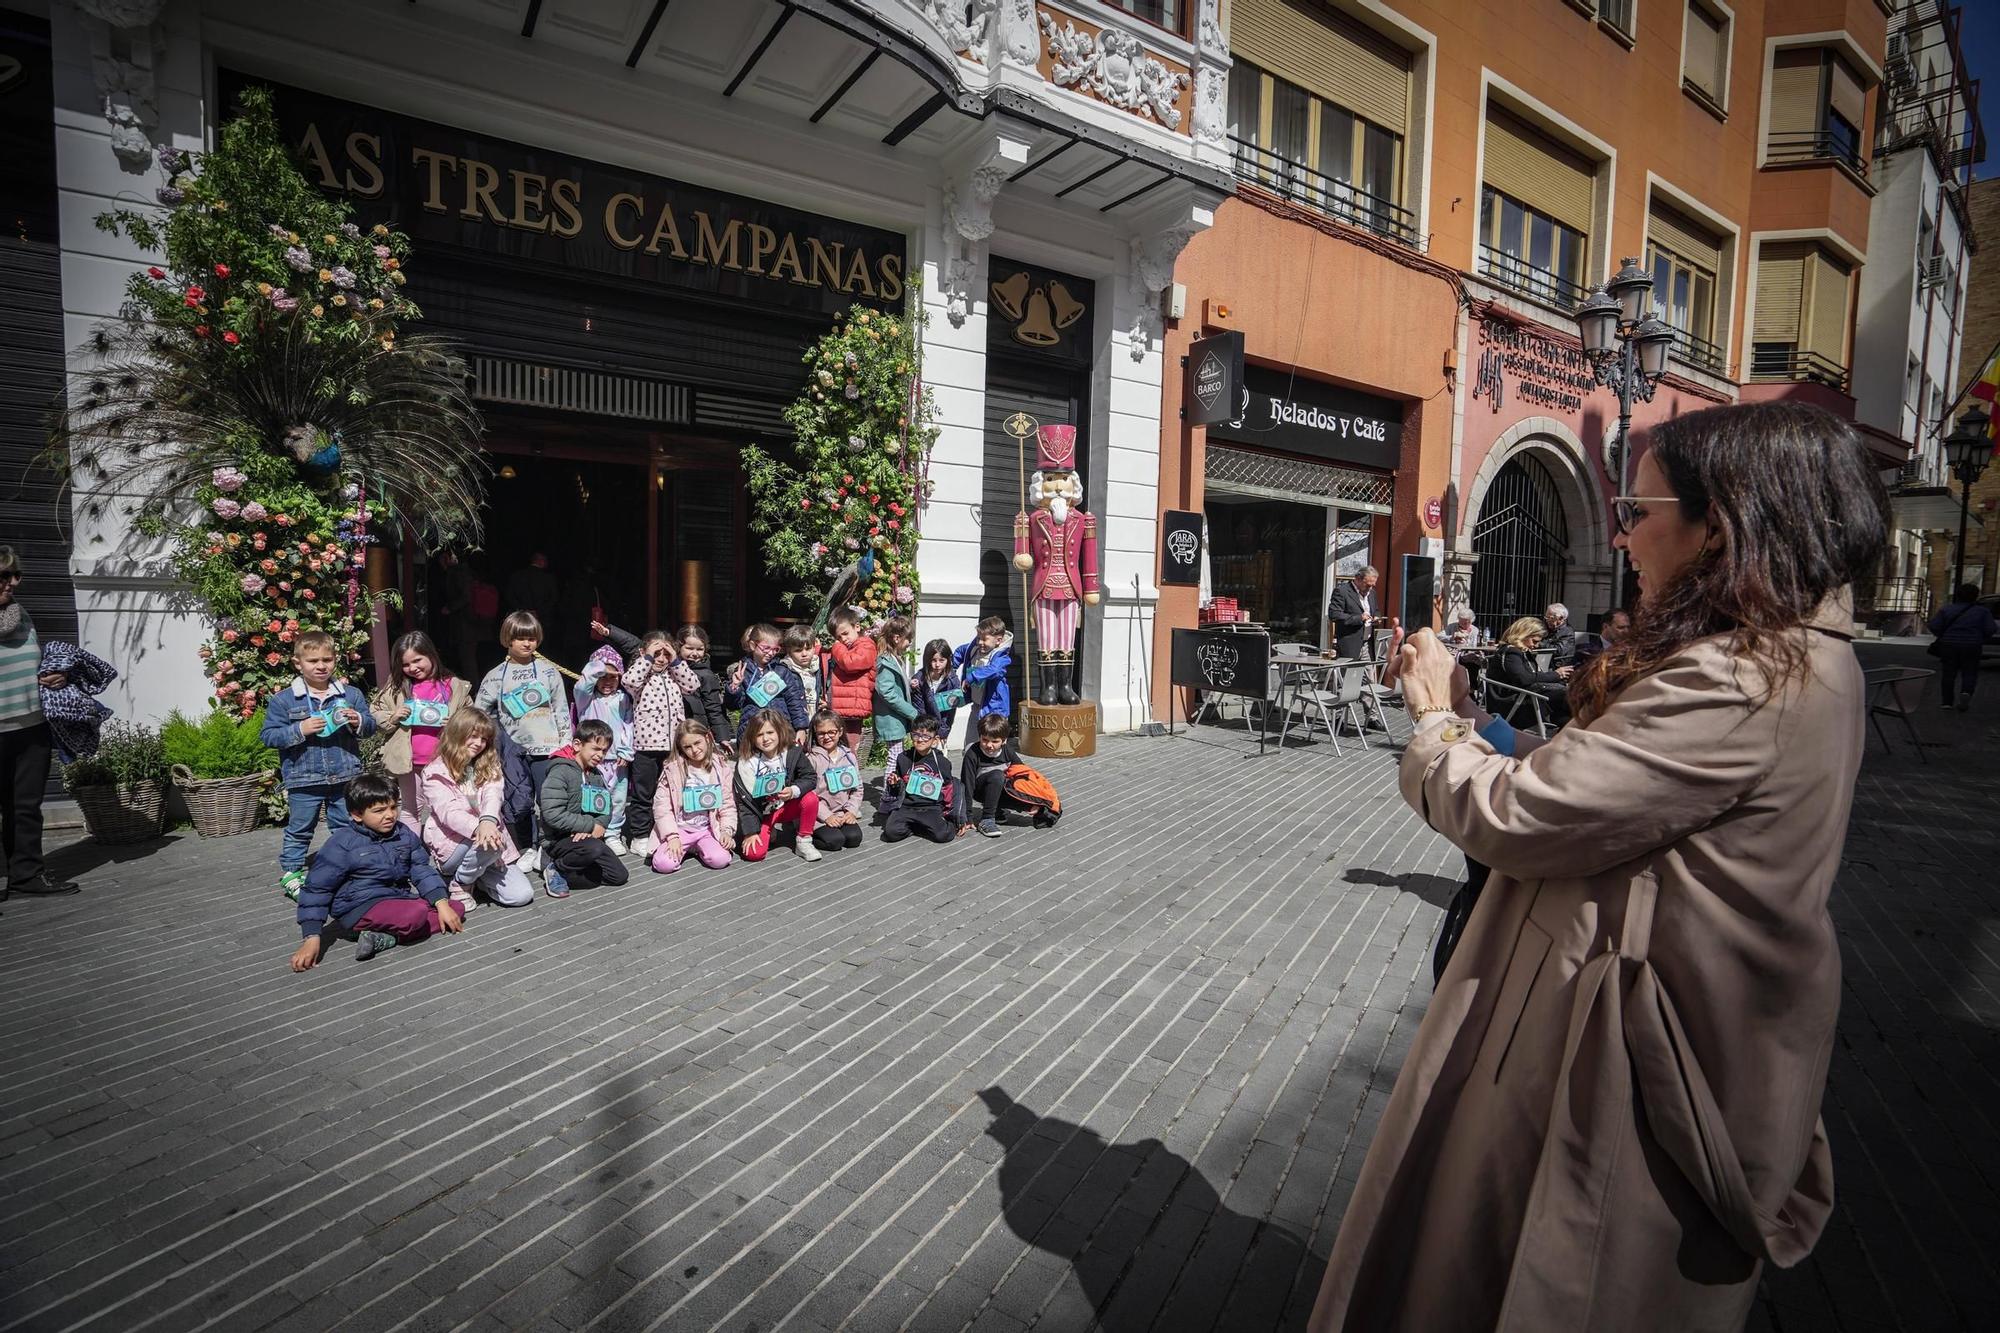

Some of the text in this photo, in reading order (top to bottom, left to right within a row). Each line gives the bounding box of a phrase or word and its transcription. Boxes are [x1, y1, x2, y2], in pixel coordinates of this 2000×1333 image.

[296, 122, 903, 303] AS TRES CAMPANAS
[1198, 381, 1222, 395] BARCO
[1339, 417, 1349, 439] y
[1353, 416, 1385, 442] Café
[1030, 713, 1058, 730] TRES
